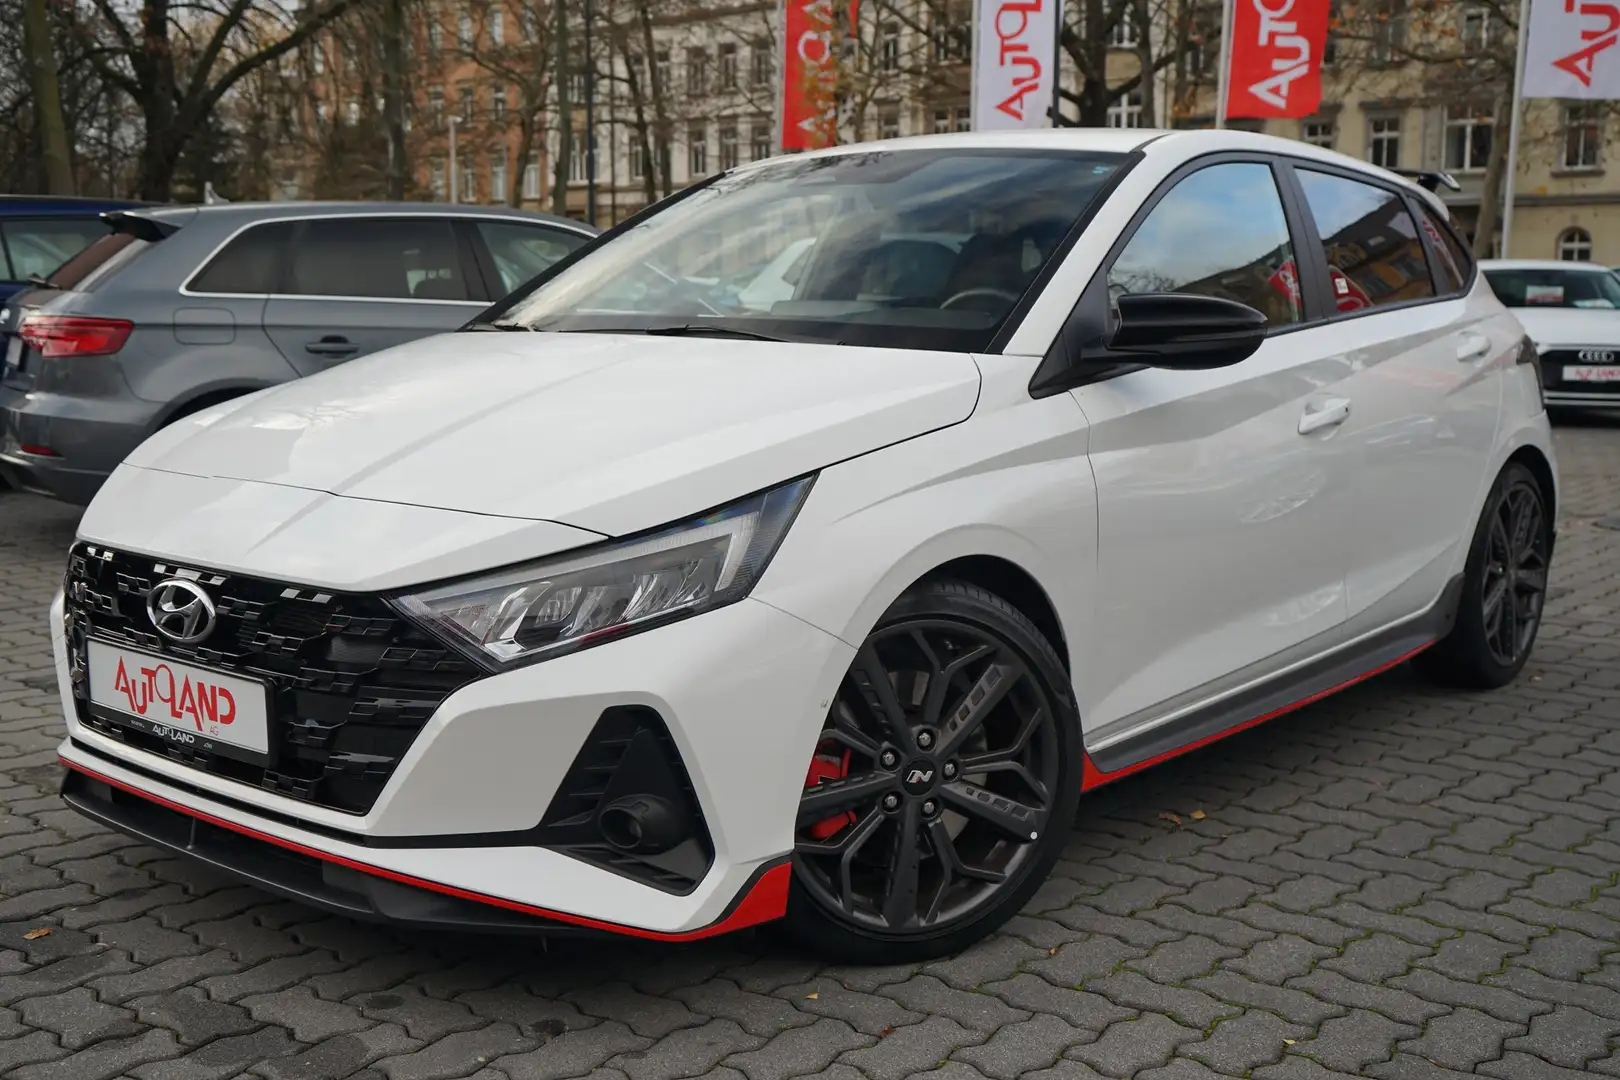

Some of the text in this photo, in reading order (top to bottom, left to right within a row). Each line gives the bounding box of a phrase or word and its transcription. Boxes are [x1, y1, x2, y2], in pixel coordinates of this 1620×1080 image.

[114, 655, 236, 732] AUTOLAND
[152, 724, 195, 744] AUTOLAND
[209, 725, 219, 736] AG
